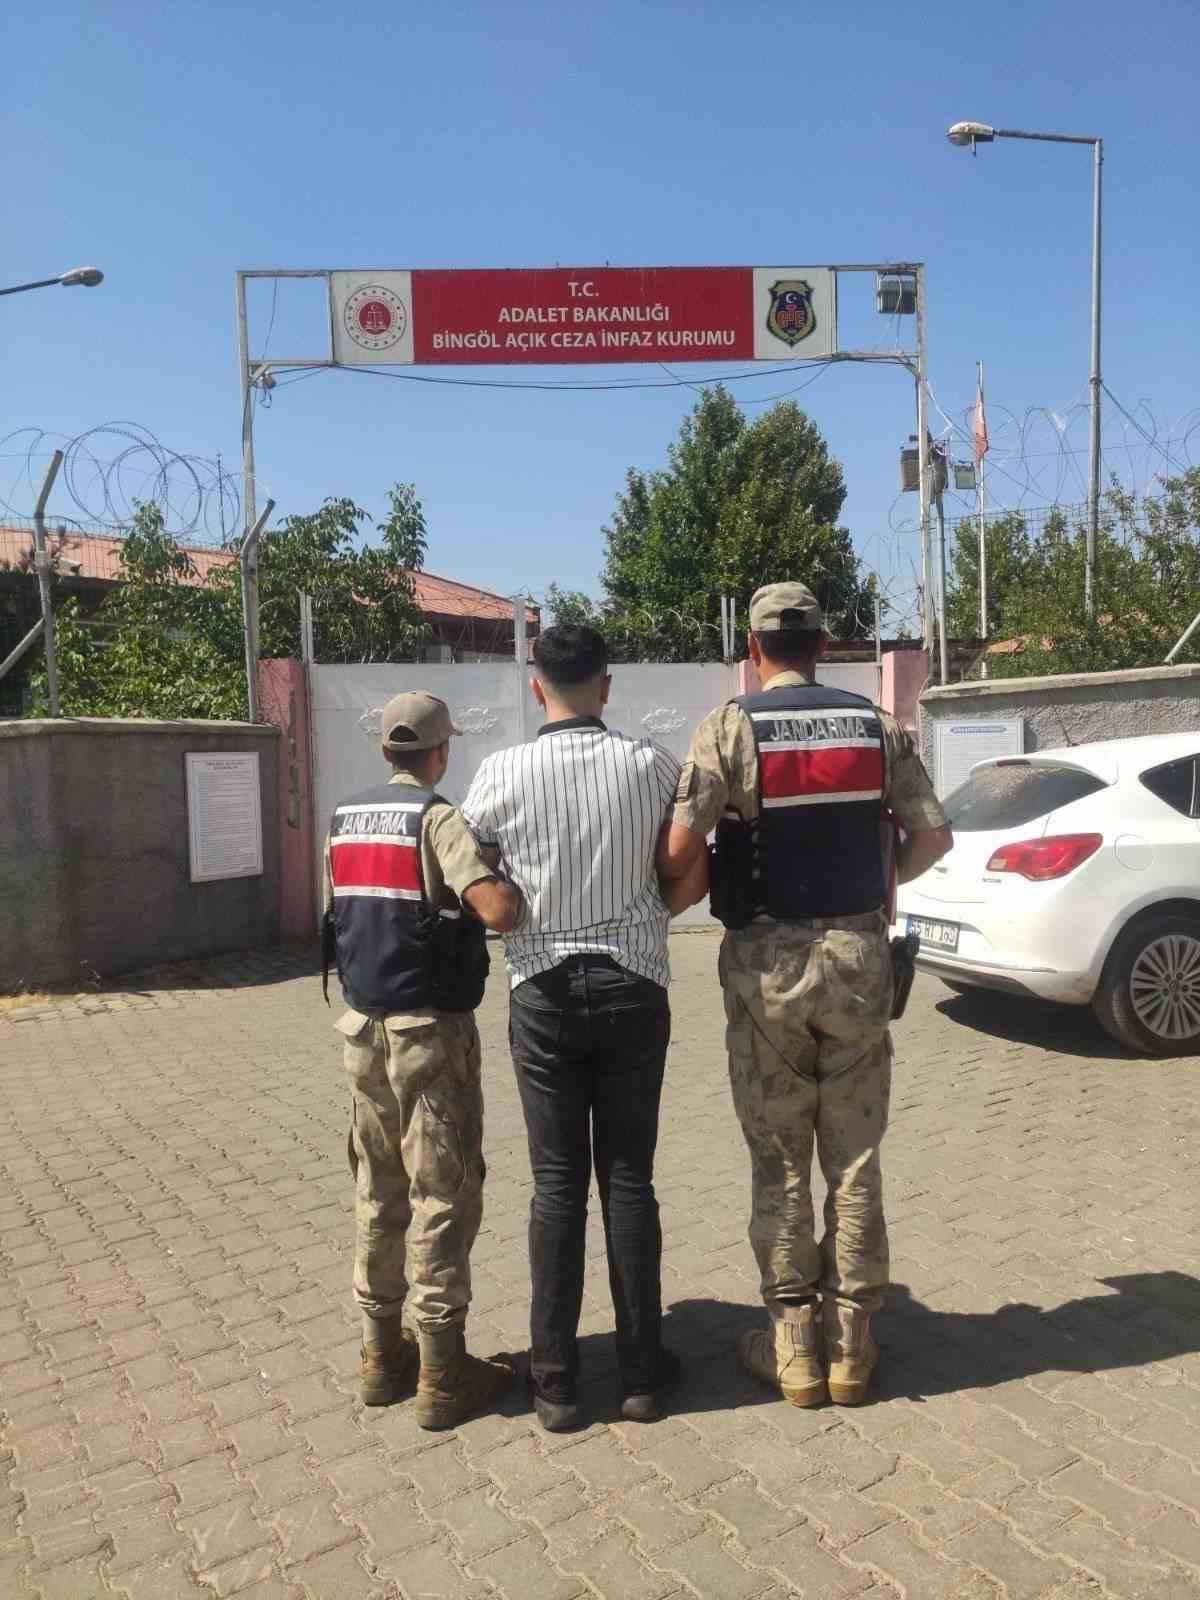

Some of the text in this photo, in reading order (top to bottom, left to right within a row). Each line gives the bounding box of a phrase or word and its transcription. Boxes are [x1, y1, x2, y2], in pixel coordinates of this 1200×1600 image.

[567, 281, 599, 297] T.C.
[498, 303, 670, 323] ADALET BAKANLIĞI
[432, 328, 736, 352] BİNGÖL AÇIK CEZA İNFAZ KURUMU
[769, 716, 869, 741] JANDARMA
[338, 811, 408, 835] JANDARMA
